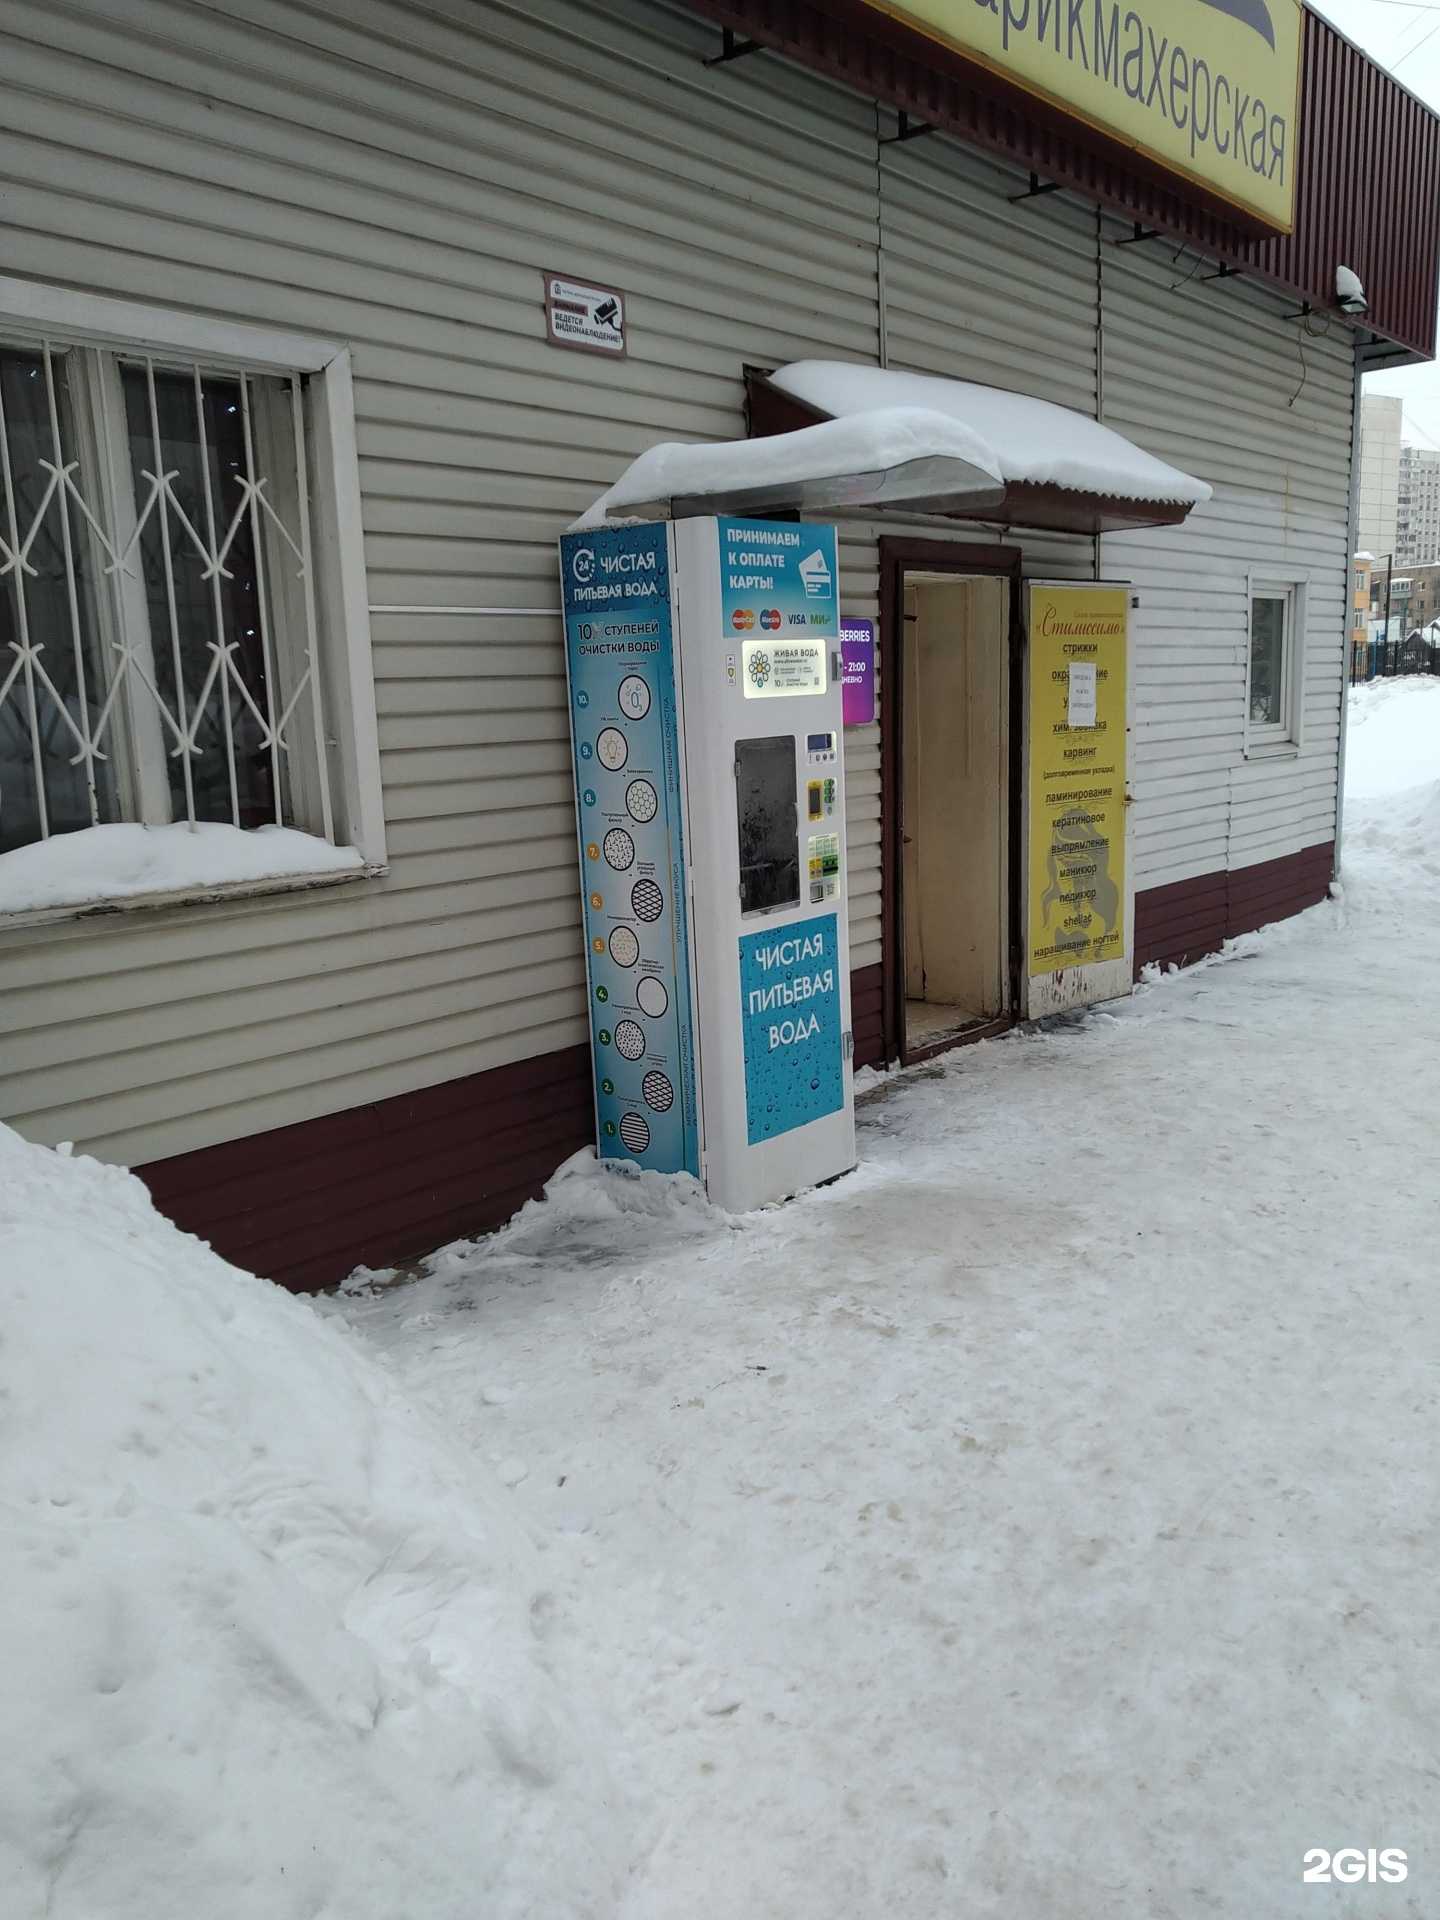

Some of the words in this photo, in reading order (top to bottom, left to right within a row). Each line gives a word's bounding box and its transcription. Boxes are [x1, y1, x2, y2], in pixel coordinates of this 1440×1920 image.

[973, 0, 1286, 187] рикмахерская
[554, 313, 583, 326] ВЕДЕТСЯ
[727, 528, 800, 546] ПРИНИМАЕМ
[578, 561, 589, 571] 24
[600, 551, 656, 574] ЧИСТАЯ
[728, 552, 737, 565] К
[740, 552, 785, 568] ОПЛАТЕ
[729, 575, 774, 590] КАРТЫ!
[574, 585, 621, 601] ПИТЬЕВАЯ
[626, 581, 658, 597] ВОДА
[788, 614, 806, 625] VISA
[578, 623, 592, 641] 10
[604, 619, 659, 637] СТУПЕНЕЙ
[578, 643, 625, 656] ОЧИСТКИ
[627, 640, 660, 655] ВОДЫ
[774, 649, 799, 658] ЖИВАЯ
[800, 648, 819, 657] ВОДА
[1063, 644, 1098, 655] стрижки
[848, 661, 866, 672] 21:00
[1063, 747, 1097, 761] карвинг
[1045, 787, 1113, 803] ламинирование
[1052, 812, 1106, 830] кератиновое
[1059, 864, 1097, 878] маникюр
[1063, 912, 1093, 928] shellac
[755, 933, 824, 971] ЧИСТАЯ
[1033, 938, 1091, 959] наращивание
[1093, 931, 1119, 946] ногтей
[750, 968, 834, 1015] ПИТЬЕВАЯ
[769, 1012, 820, 1049] ВОДА
